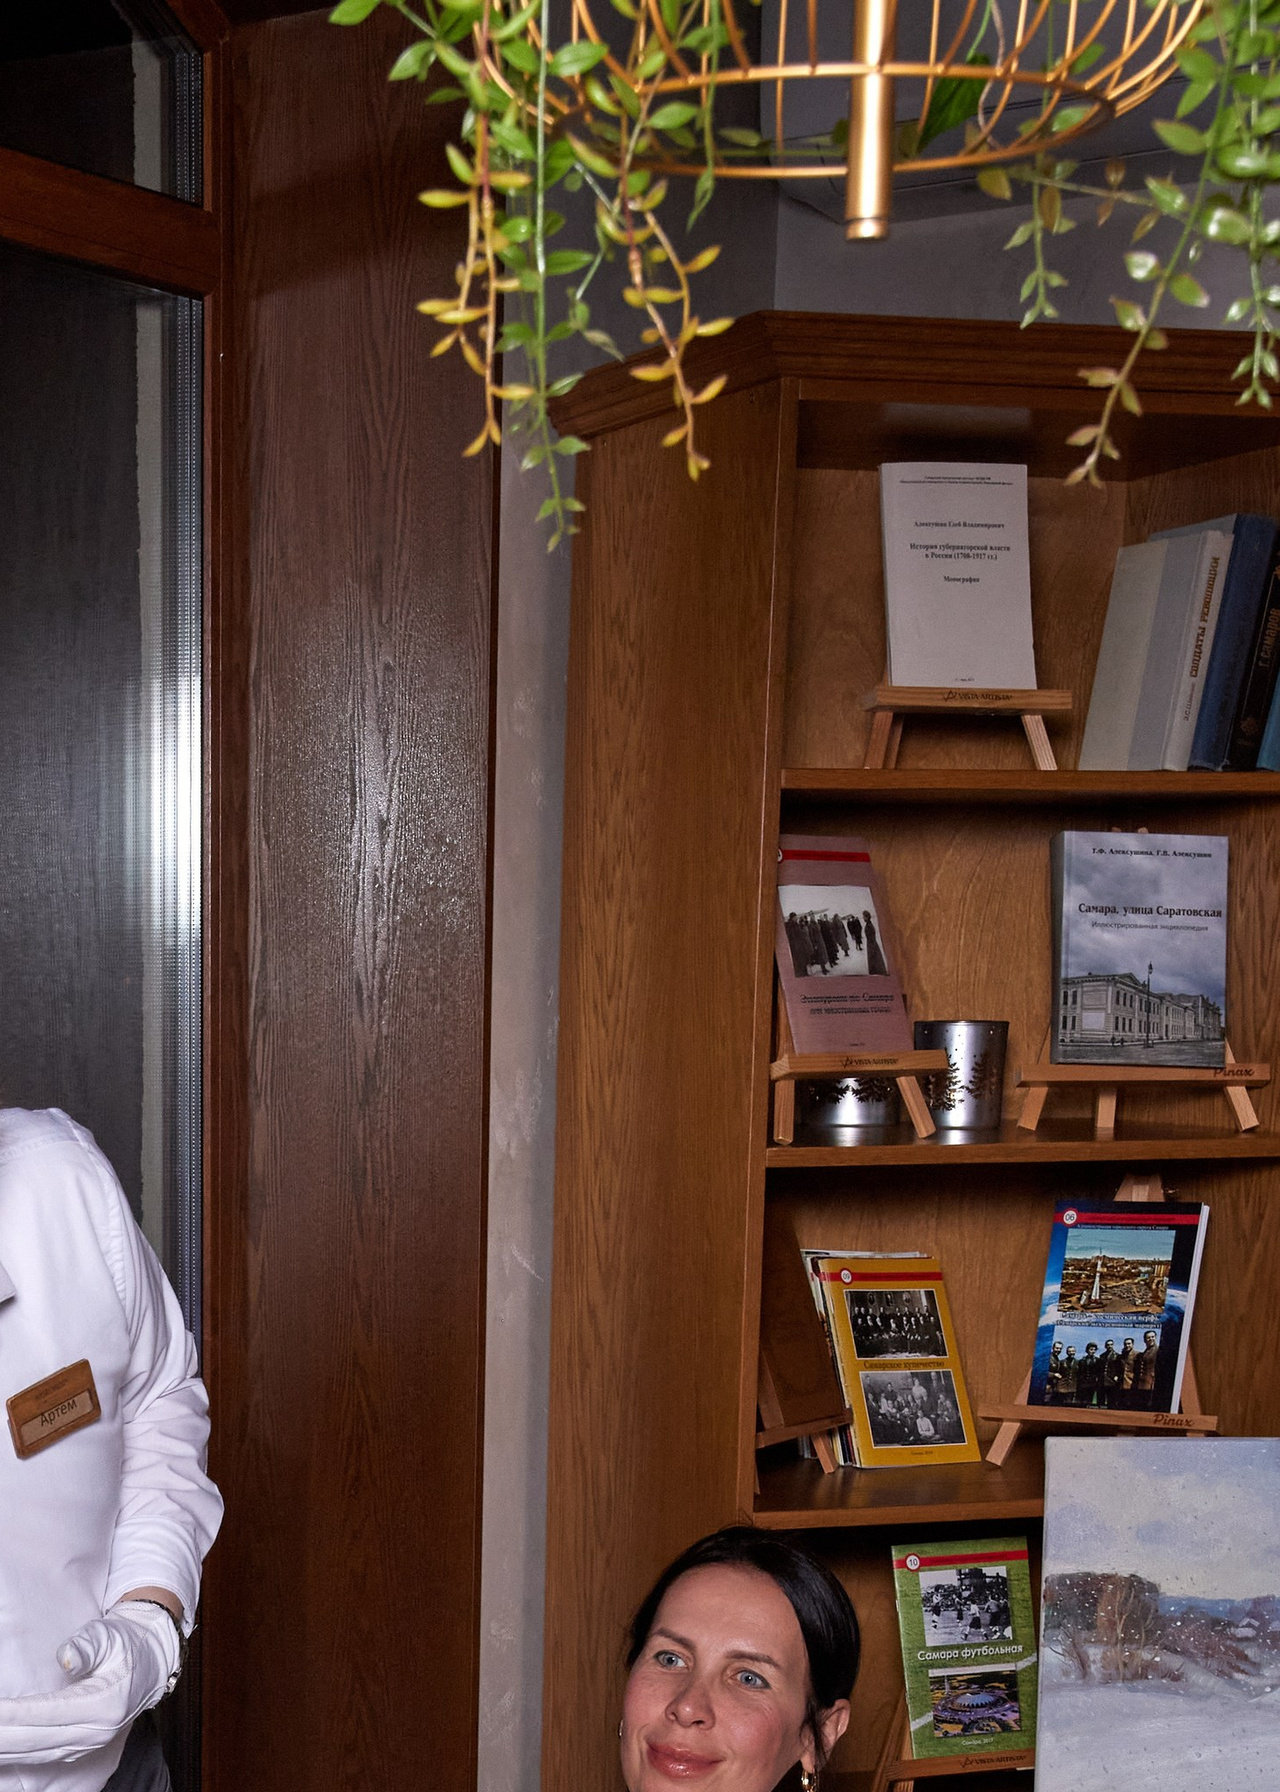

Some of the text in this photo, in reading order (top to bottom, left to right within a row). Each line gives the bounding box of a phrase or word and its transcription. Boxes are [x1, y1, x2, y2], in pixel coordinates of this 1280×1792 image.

[910, 543, 938, 551] История
[939, 543, 988, 552] губернаторской
[943, 576, 980, 584] Монография
[1189, 625, 1207, 678] СОЛДАТЫ
[1172, 850, 1212, 859] Алексушин
[1078, 903, 1222, 918] Самара, улица Саратовская
[1091, 920, 1209, 932] Иллюстрированная энциклопедия
[1213, 1067, 1255, 1078] Pinax
[1065, 1213, 1075, 1221] 06
[842, 1272, 851, 1280] 09
[863, 1360, 944, 1370] Самарское купечество
[41, 1399, 77, 1427] Артем
[1153, 1413, 1194, 1427] Pinax
[909, 1558, 918, 1567] 10
[917, 1644, 1023, 1661] Самара футбольная
